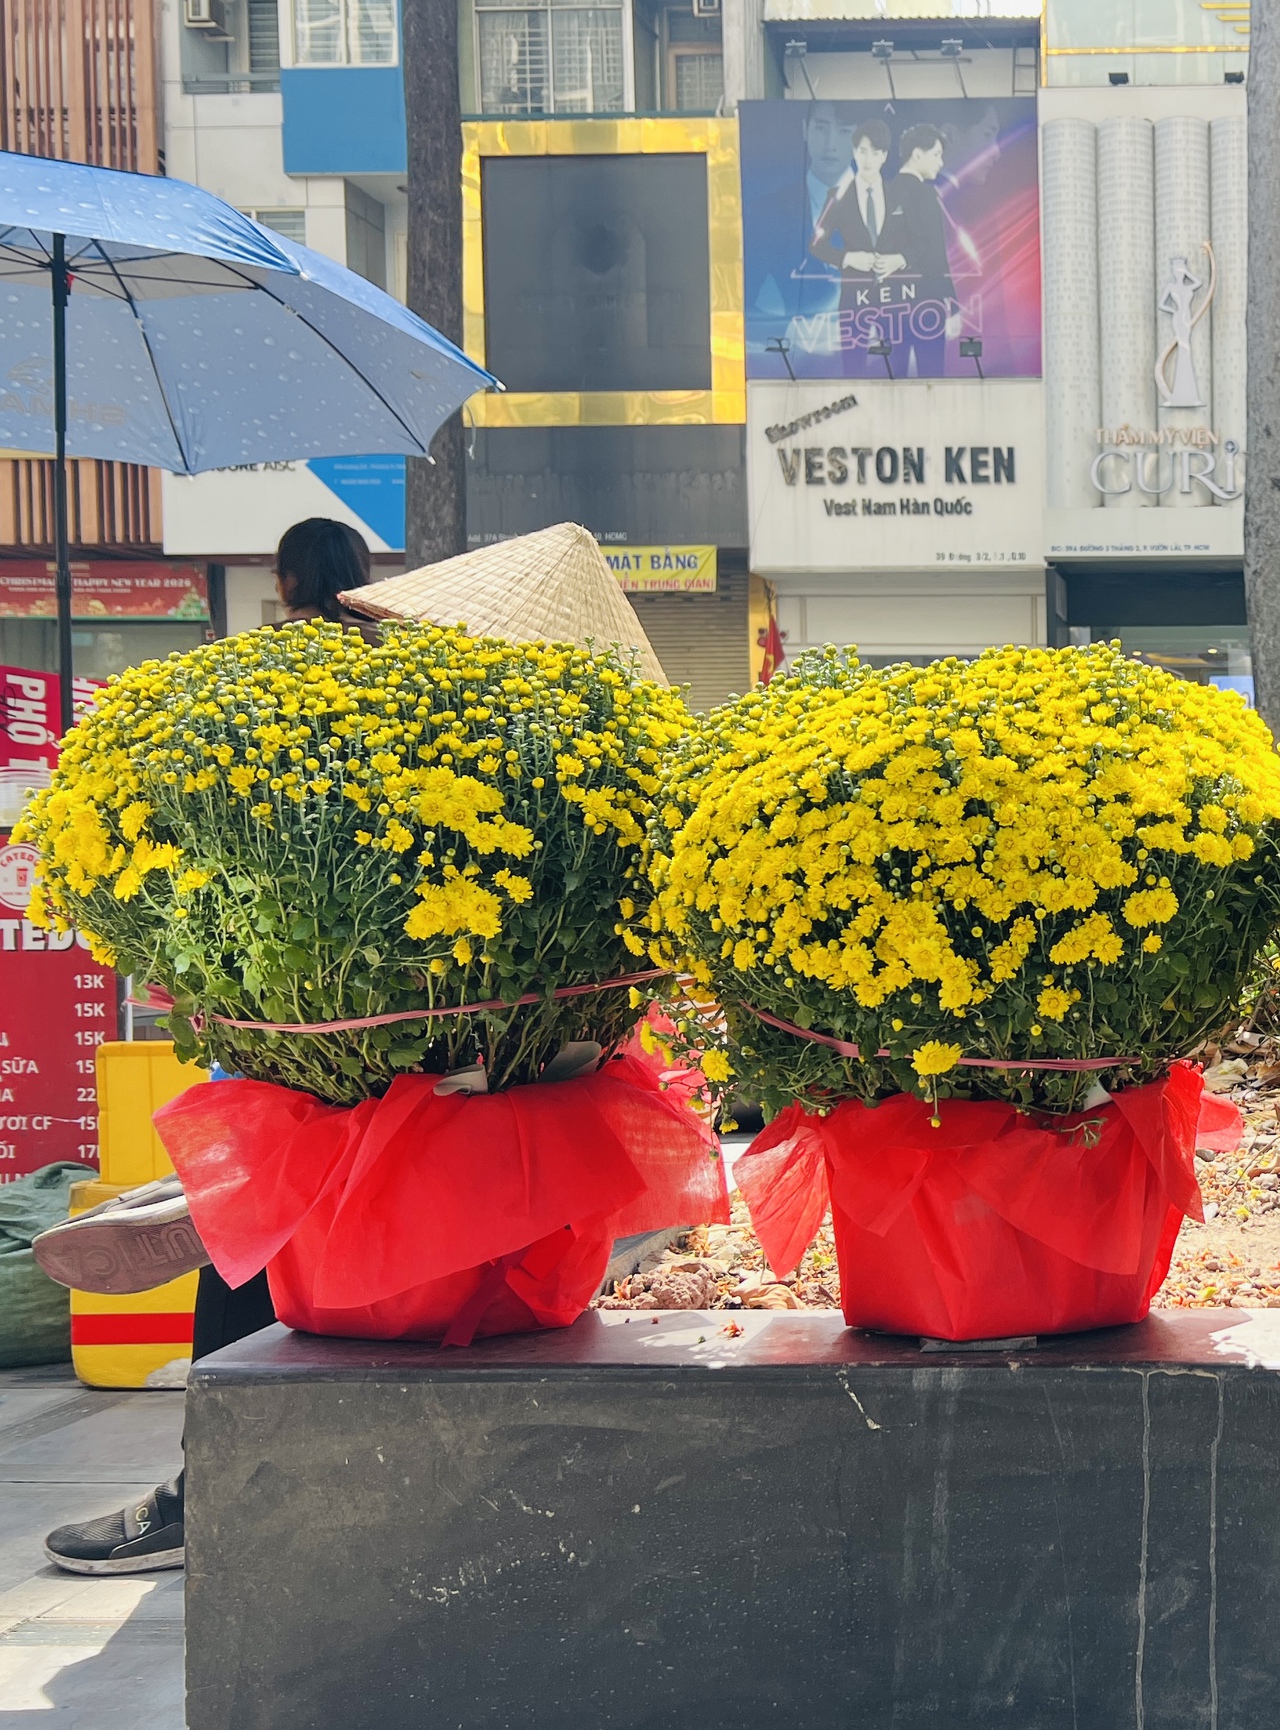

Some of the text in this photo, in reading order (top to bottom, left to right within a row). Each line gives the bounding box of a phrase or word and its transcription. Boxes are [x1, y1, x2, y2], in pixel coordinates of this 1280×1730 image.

[855, 283, 916, 306] KEN
[791, 293, 984, 354] VESTON
[777, 446, 1017, 486] VESTON KEN
[823, 496, 973, 517] Vest Nam Hàn Quốc
[73, 578, 108, 588] HAPPY
[111, 578, 132, 588] NEW
[135, 578, 161, 588] YEAR
[163, 578, 192, 588] 2026
[73, 974, 105, 989] 13K
[74, 1002, 105, 1018] 15K
[74, 1031, 106, 1046] 15K
[1, 1056, 39, 1075] SỮA
[31, 1116, 52, 1131] CF
[79, 1115, 99, 1131] 15
[77, 1144, 101, 1159] 17
